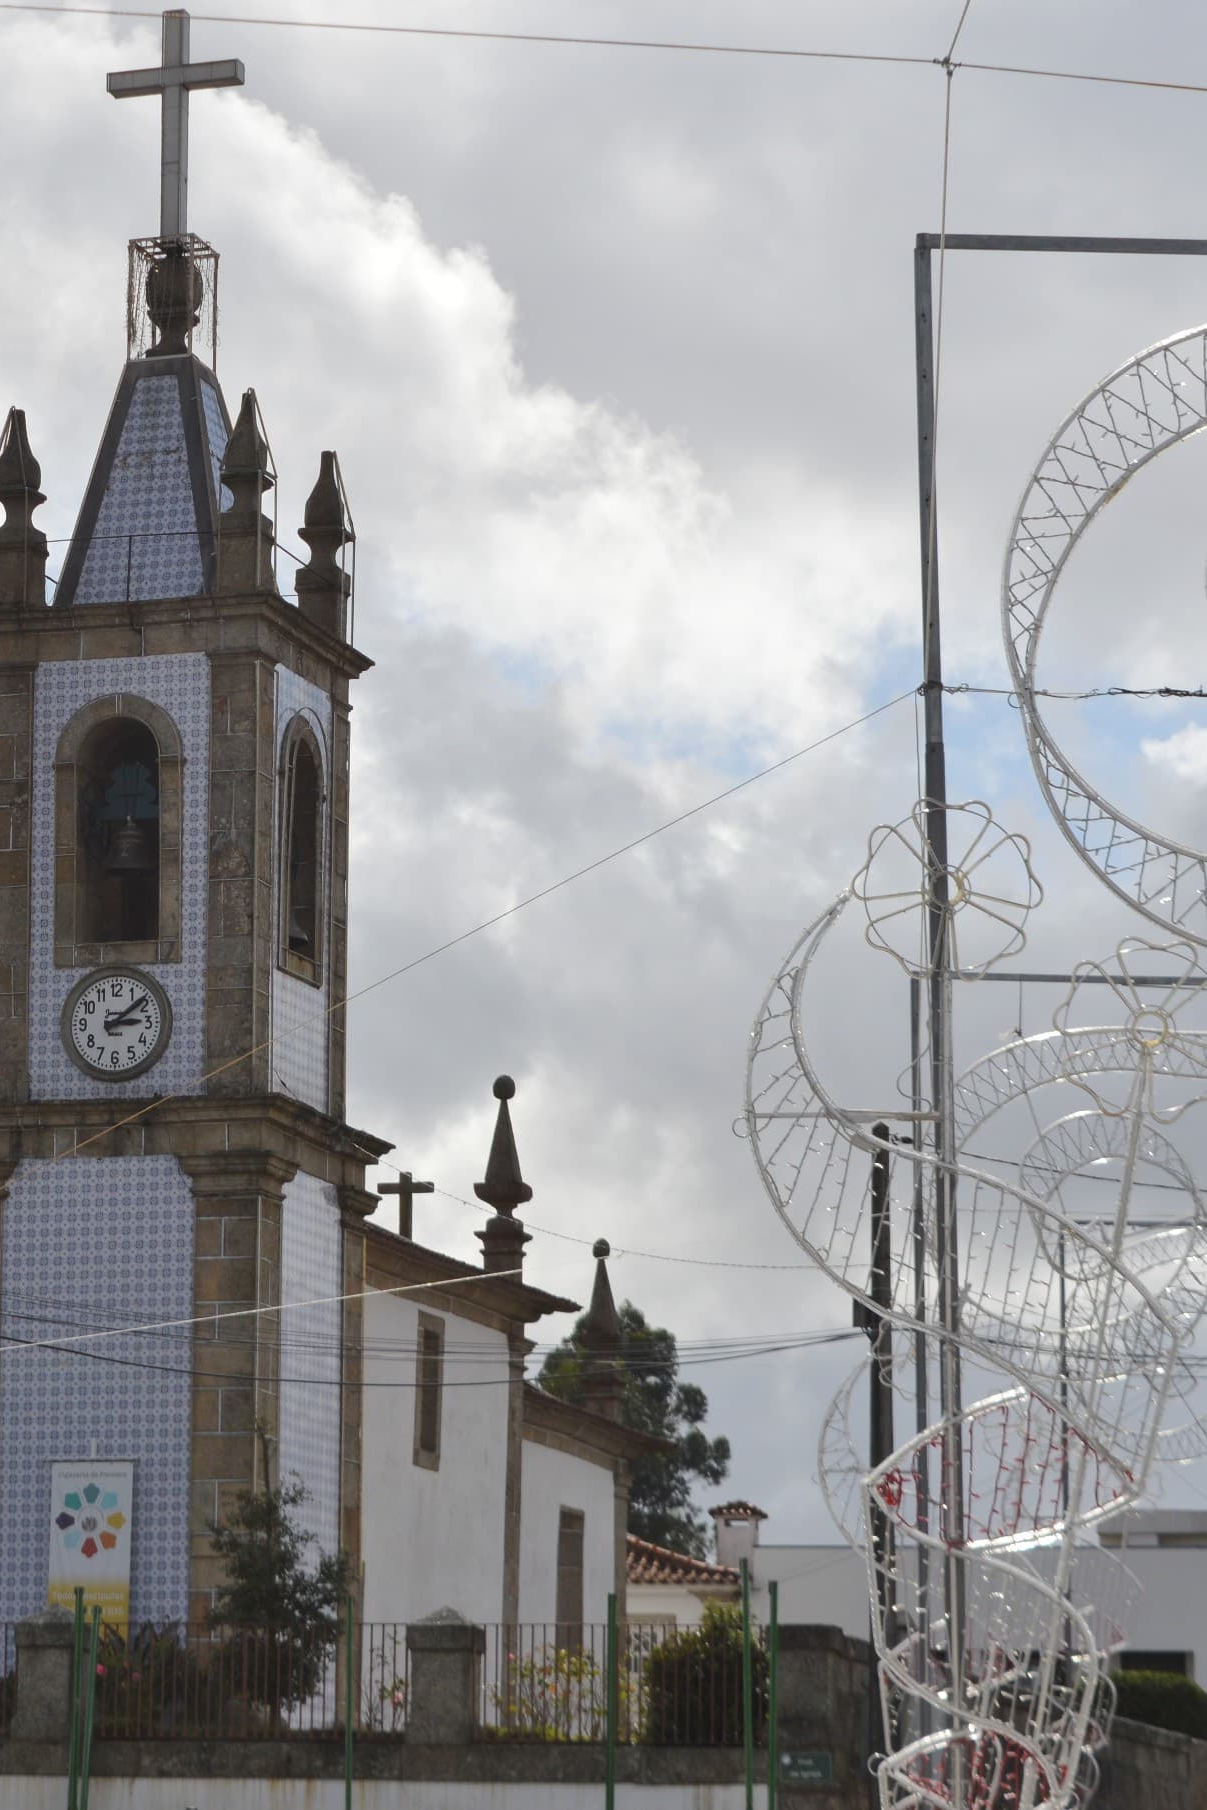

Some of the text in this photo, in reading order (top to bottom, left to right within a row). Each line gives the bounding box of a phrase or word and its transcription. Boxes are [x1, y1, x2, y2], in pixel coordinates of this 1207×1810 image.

[96, 988, 106, 1002] 11
[110, 983, 123, 997] 12
[129, 988, 134, 1001] 1
[83, 1000, 95, 1014] 10
[140, 999, 149, 1013] 2
[79, 1018, 87, 1032] 9
[144, 1016, 153, 1029] 3
[87, 1034, 95, 1048] 8
[138, 1032, 147, 1046] 4
[97, 1047, 105, 1061] 7
[111, 1051, 119, 1065] 6
[127, 1046, 136, 1060] 5
